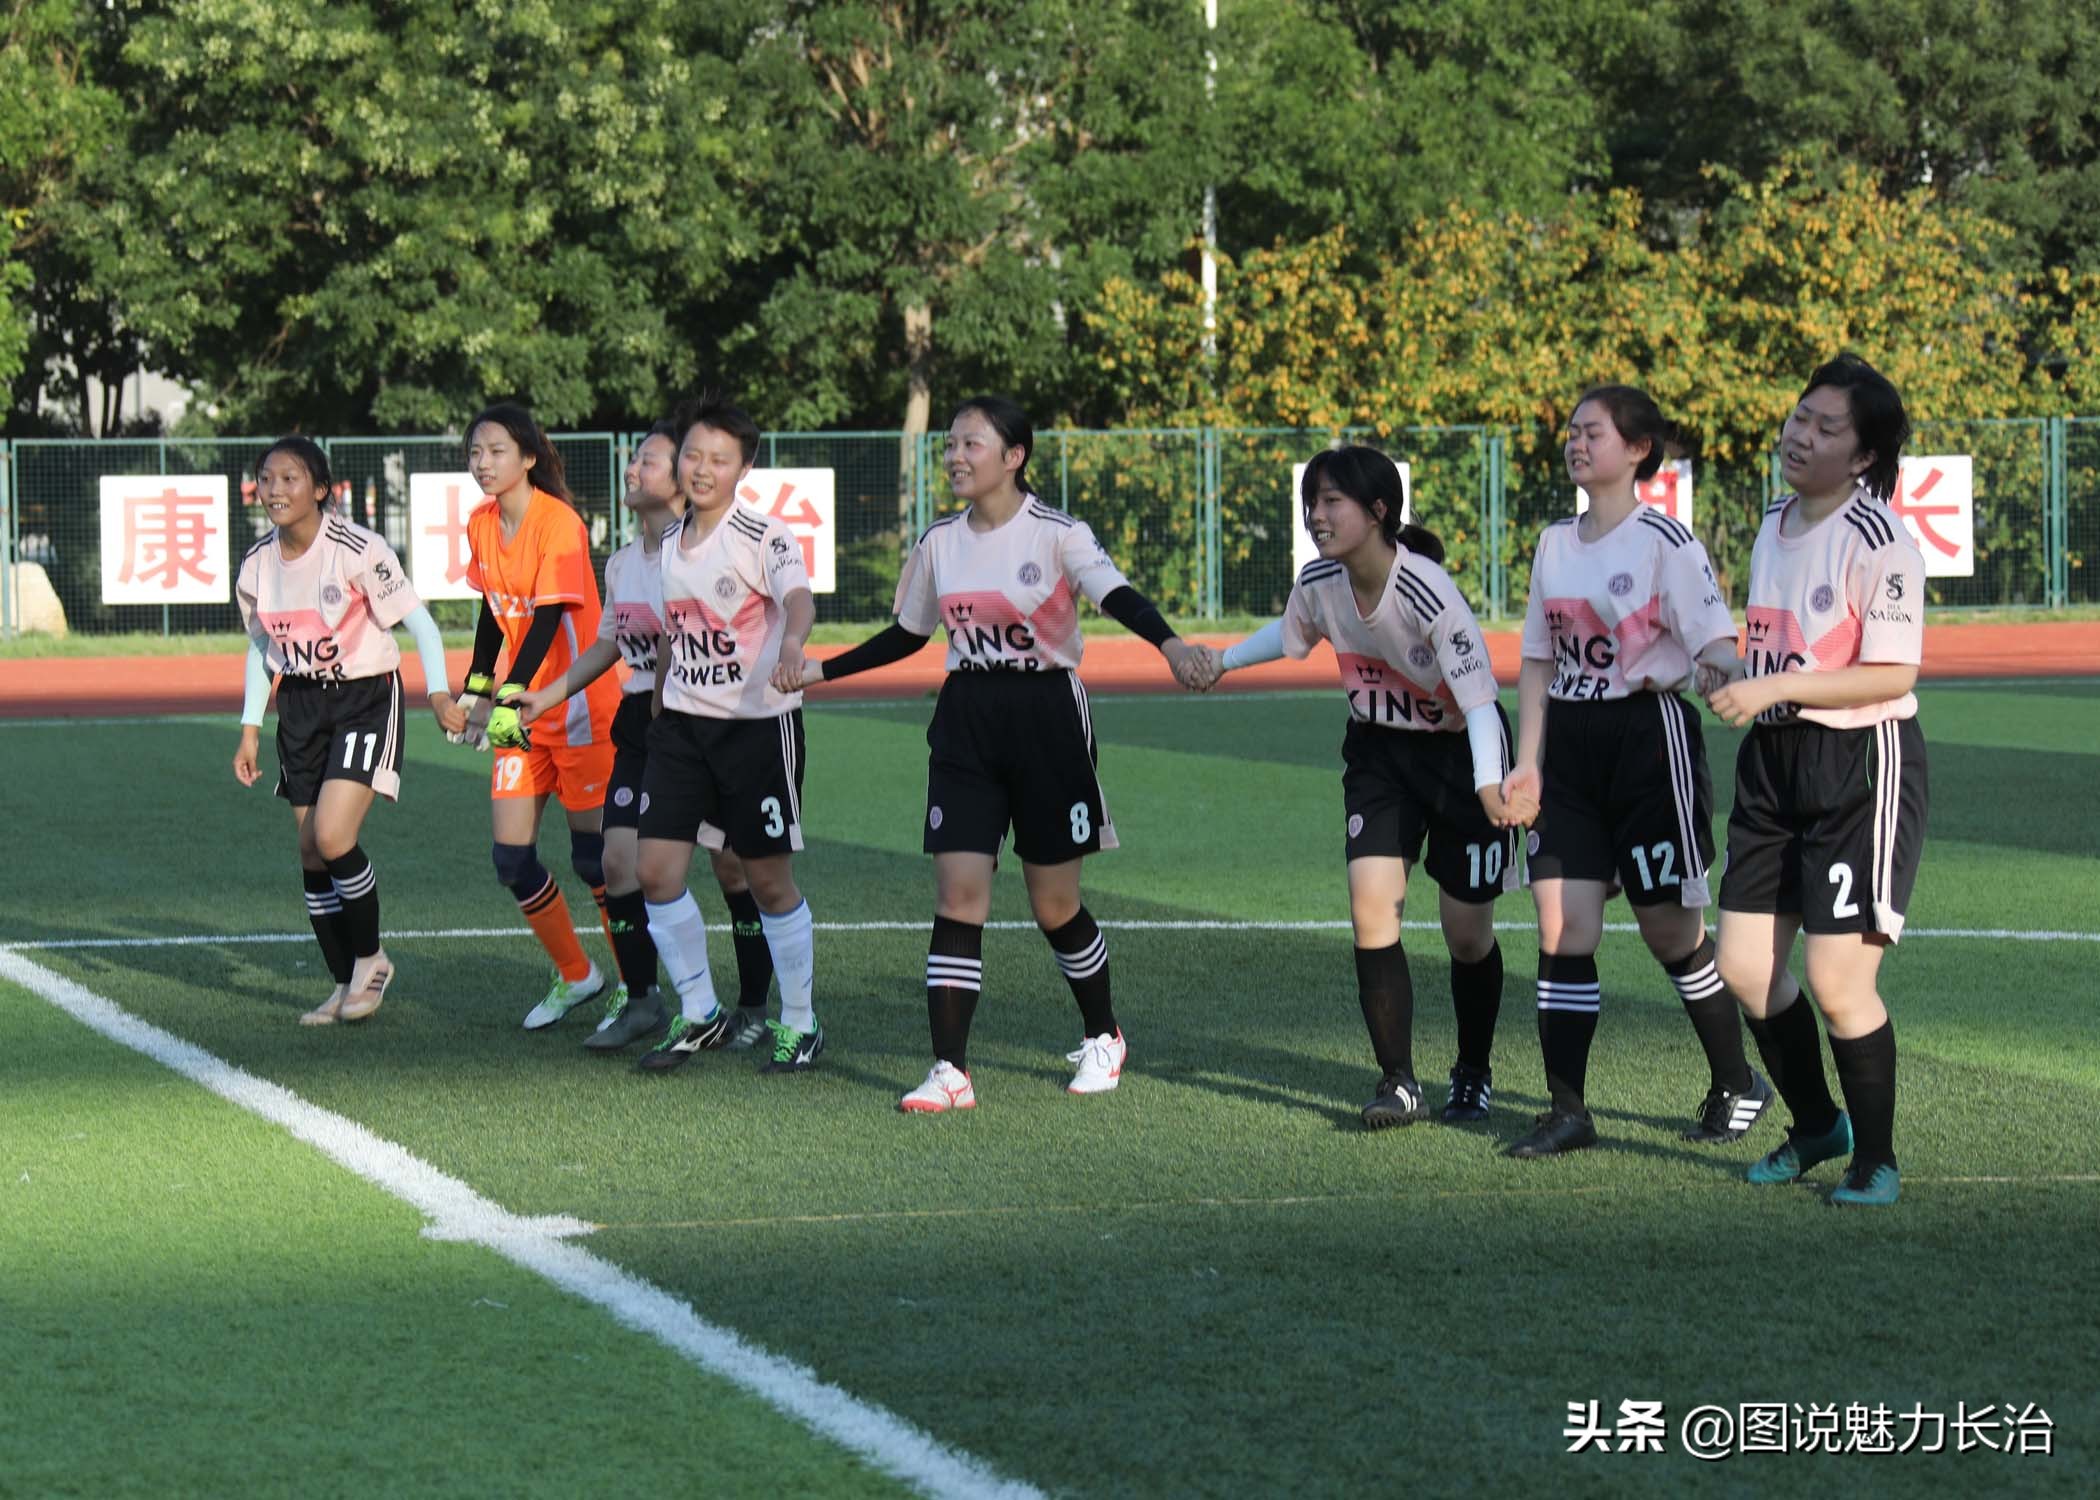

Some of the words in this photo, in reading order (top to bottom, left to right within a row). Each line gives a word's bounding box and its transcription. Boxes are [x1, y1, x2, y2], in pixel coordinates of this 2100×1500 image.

[1889, 466, 1961, 558] 长
[118, 488, 217, 589] 康
[342, 731, 377, 772] 11
[496, 755, 523, 792] 19
[760, 796, 785, 838] 3
[1069, 801, 1091, 844] 8
[1466, 841, 1501, 889] 10
[1631, 841, 1679, 891] 12
[1828, 862, 1859, 919] 2
